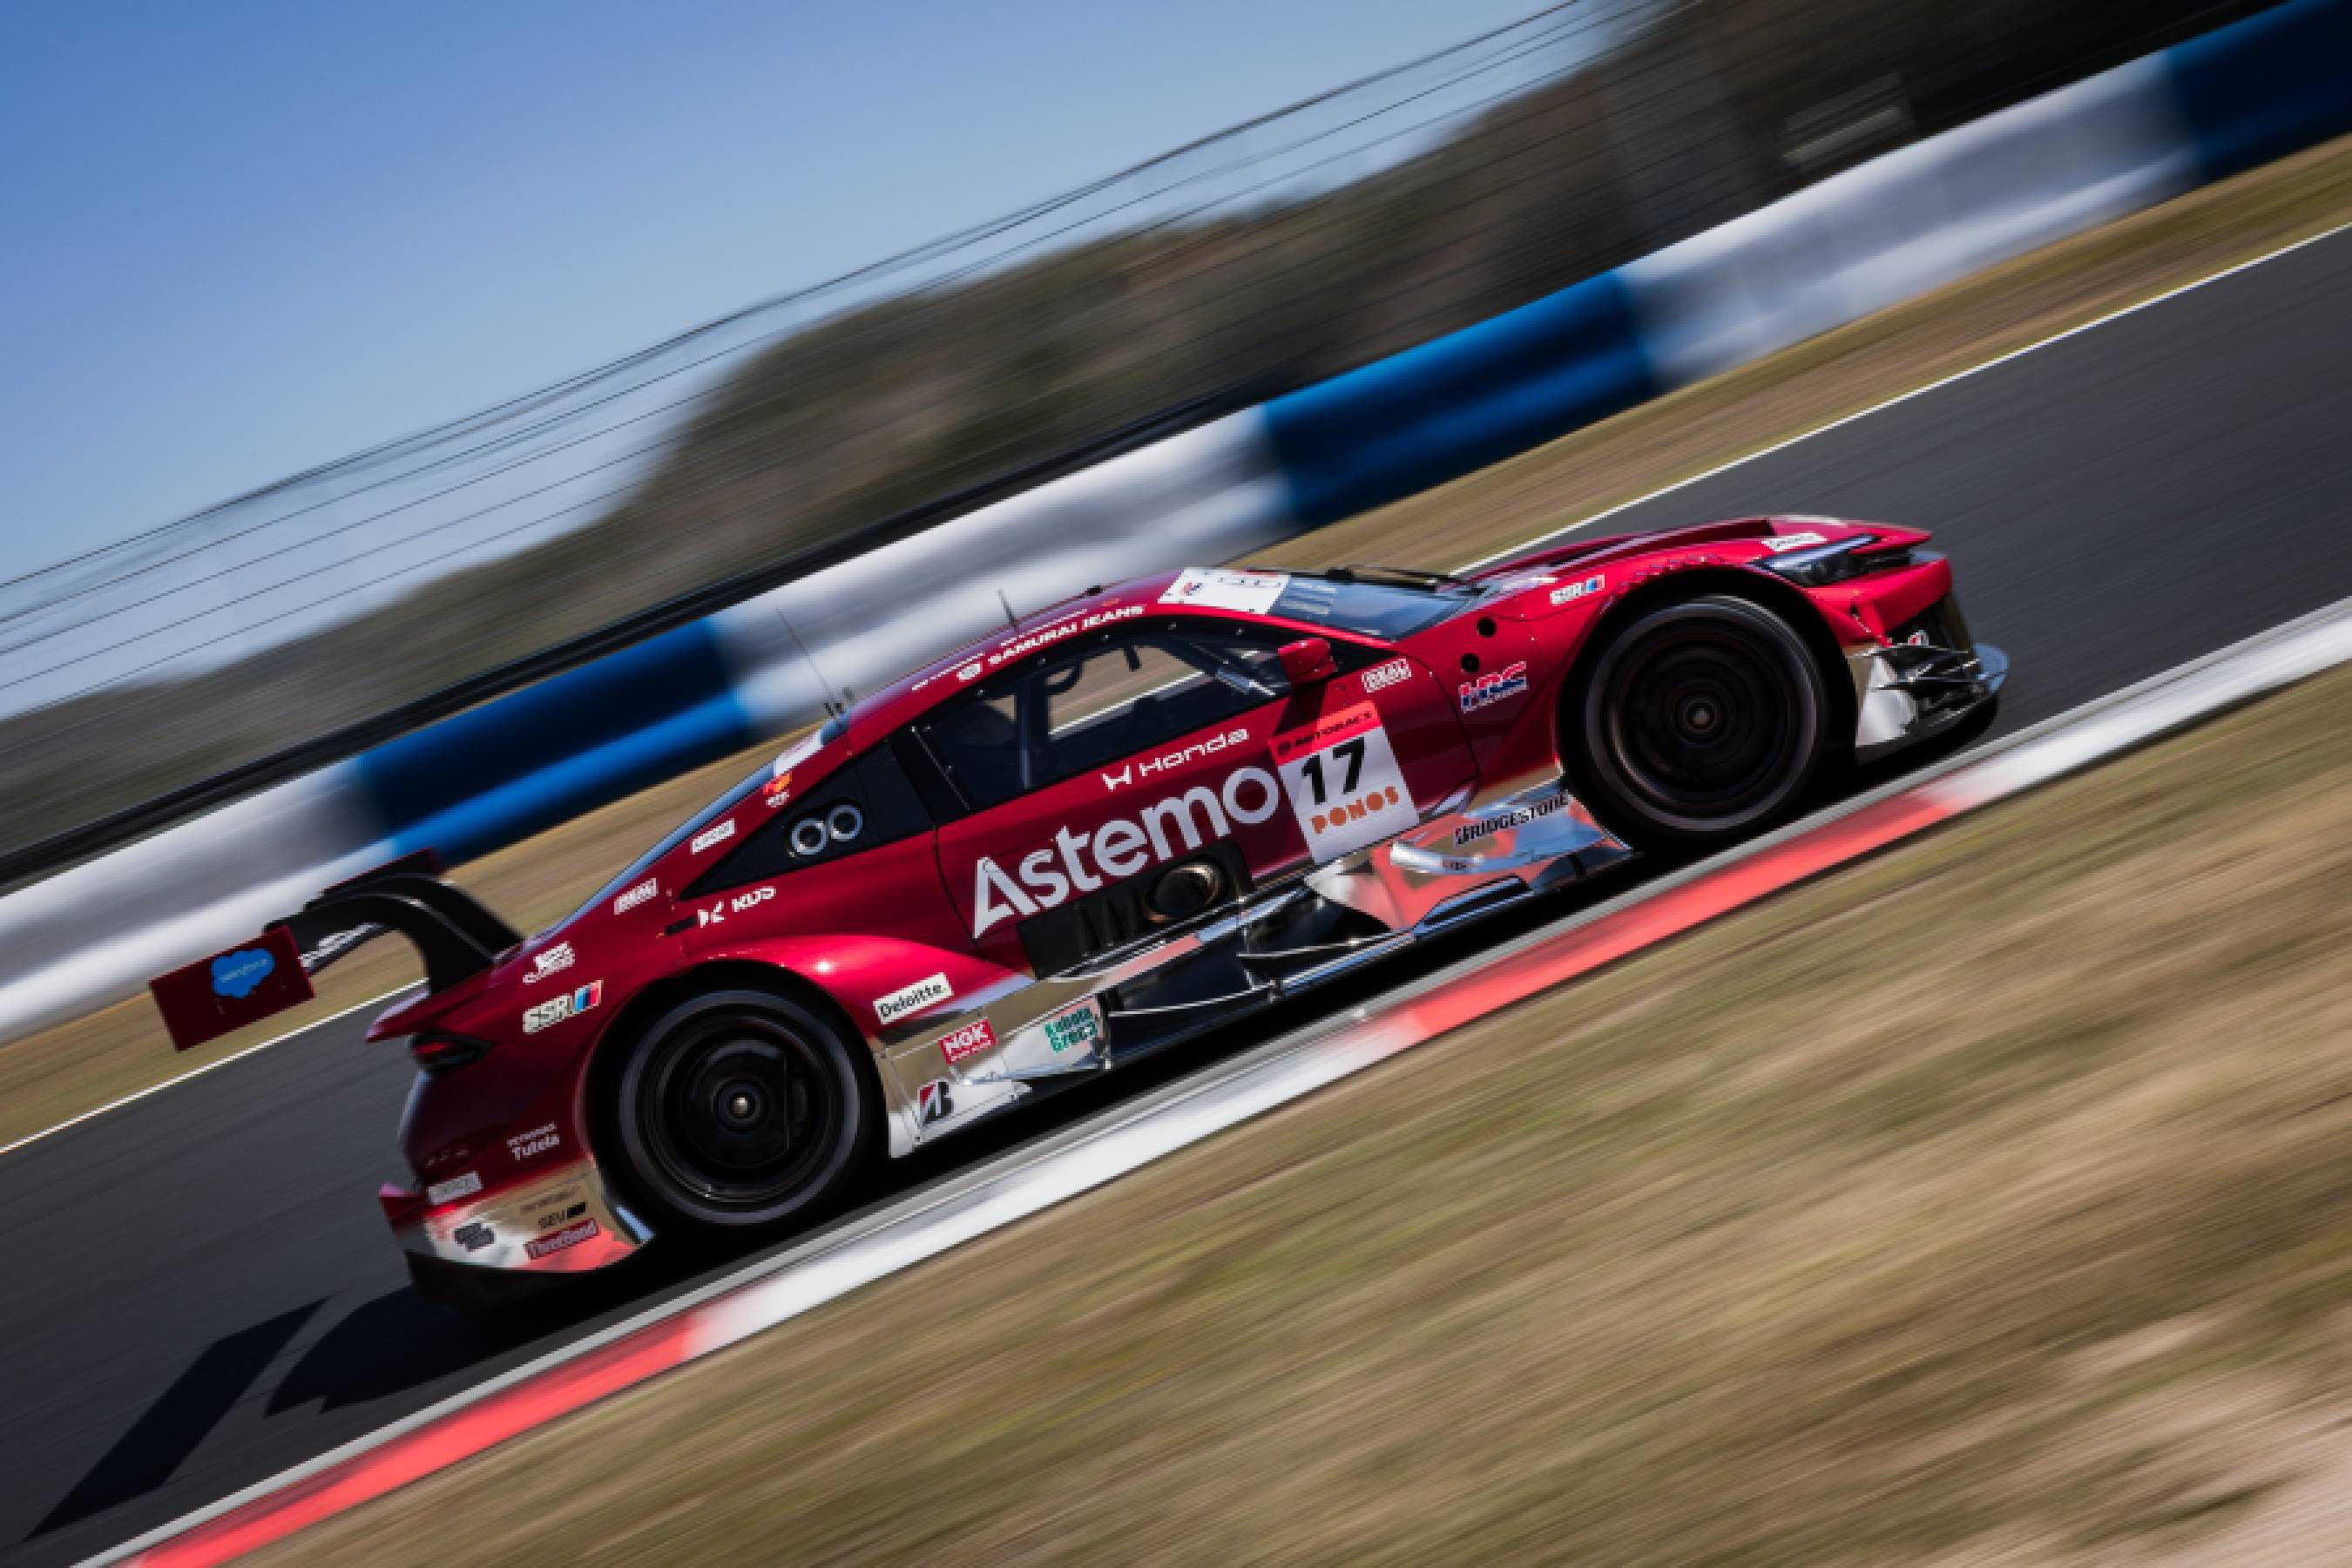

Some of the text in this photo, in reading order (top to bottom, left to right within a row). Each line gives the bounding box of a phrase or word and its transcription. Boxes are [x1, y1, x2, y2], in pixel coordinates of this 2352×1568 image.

[987, 622, 1078, 666] SAMURAI
[1082, 605, 1146, 629] JEANS
[1459, 661, 1527, 707] HRC
[1139, 729, 1249, 777] Honda
[1301, 736, 1365, 806] 17
[1309, 786, 1399, 835] PONOS
[1455, 790, 1570, 847] BRIDGESTONE
[974, 767, 1281, 940] Astemo
[523, 994, 573, 1035] SSR
[944, 1023, 989, 1055] NGK
